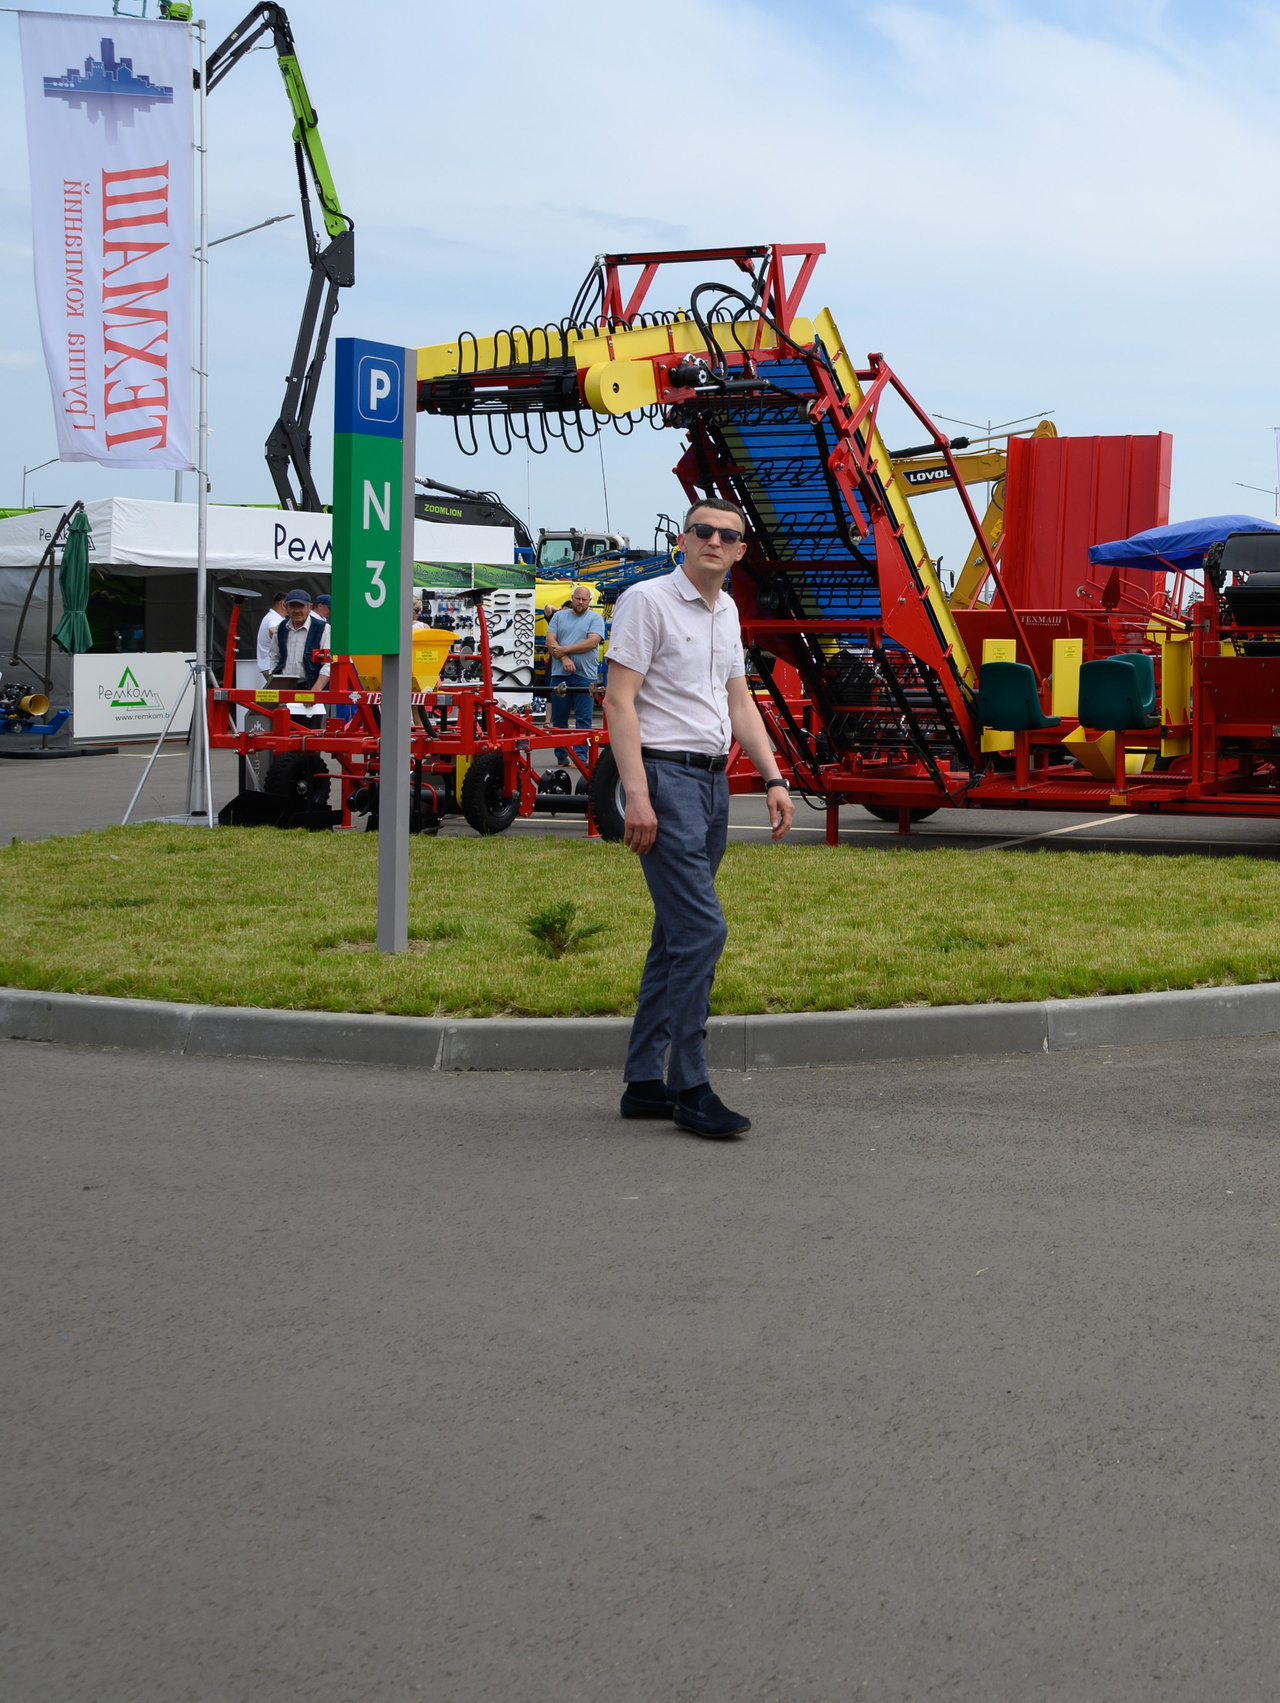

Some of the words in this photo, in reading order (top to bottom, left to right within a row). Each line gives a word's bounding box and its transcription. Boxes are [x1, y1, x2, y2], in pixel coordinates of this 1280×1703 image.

[370, 369, 391, 410] P
[910, 469, 951, 482] LOVOL
[363, 479, 390, 531] N
[424, 503, 462, 517] ZOOMLION
[274, 523, 332, 562] Рем
[364, 560, 386, 608] 3
[1020, 615, 1062, 624] ТЕХМАШ
[115, 712, 170, 721] www.remkom.b
